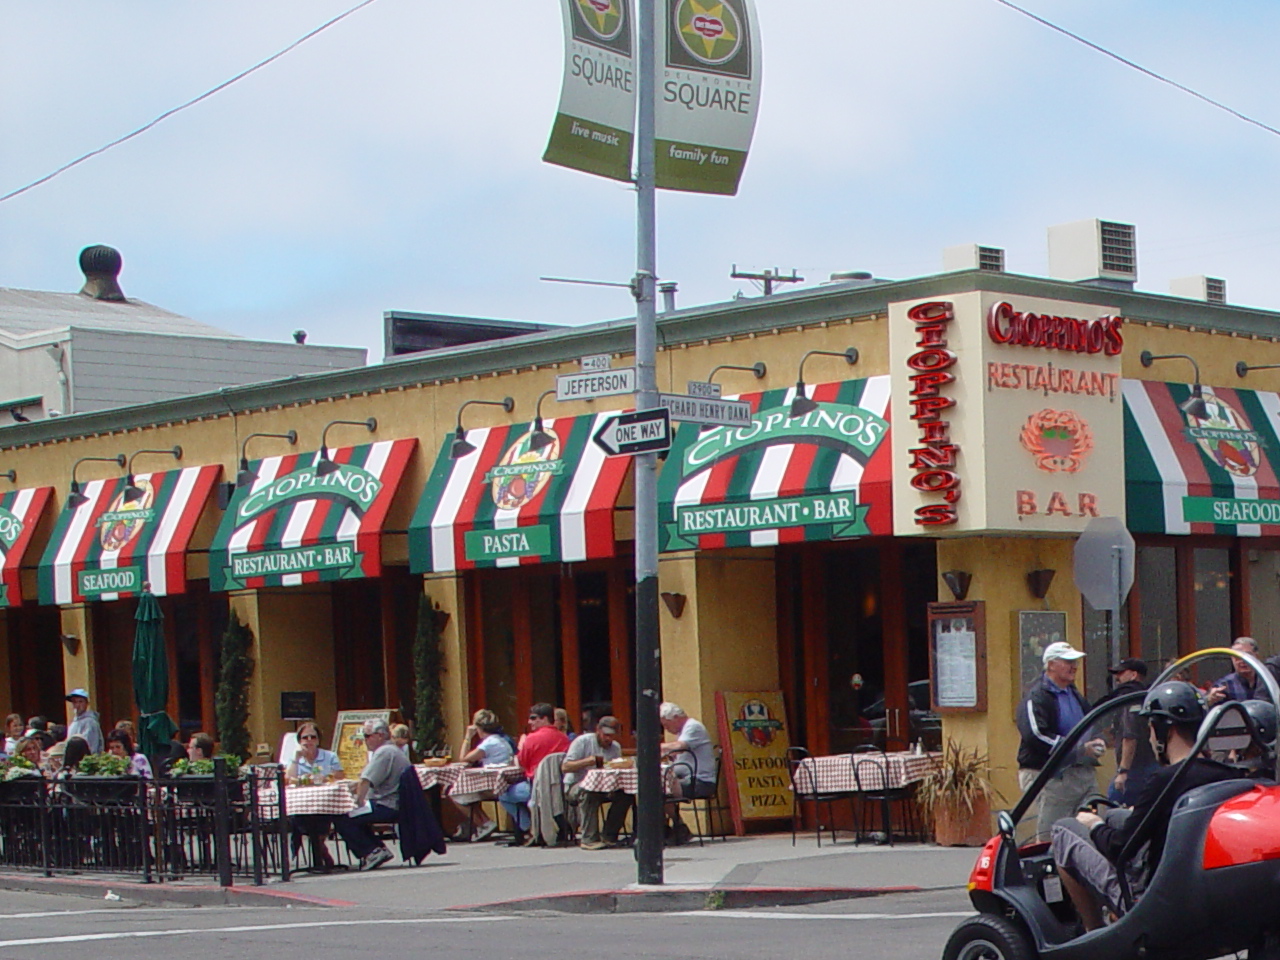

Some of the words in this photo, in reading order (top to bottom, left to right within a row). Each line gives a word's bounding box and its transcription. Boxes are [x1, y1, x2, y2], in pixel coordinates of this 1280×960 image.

[571, 54, 632, 93] SQUARE
[664, 70, 691, 81] DEL
[702, 76, 752, 91] MONTE
[663, 81, 751, 114] SQUARE
[571, 121, 590, 137] live
[592, 131, 620, 146] music
[669, 145, 708, 165] family
[710, 151, 729, 165] fun
[987, 301, 1124, 356] CIOPPINO'S
[564, 374, 628, 396] JEFFERSON
[987, 362, 1120, 398] RESTAURANT
[699, 403, 726, 420] HENRY
[729, 405, 749, 421] DANA
[907, 301, 962, 525] CIOPPINO'S
[616, 426, 637, 443] ONE
[641, 421, 662, 439] WAY
[683, 504, 800, 531] RESTAURANT
[814, 497, 852, 520] BAR
[1015, 490, 1101, 518] BAR
[483, 533, 530, 554] PASTA
[233, 550, 316, 576] RESTAURANT
[324, 546, 352, 565] BAR
[83, 570, 135, 592] SEAFOOD
[747, 775, 785, 789] PASTA
[751, 793, 788, 808] PIZZA
